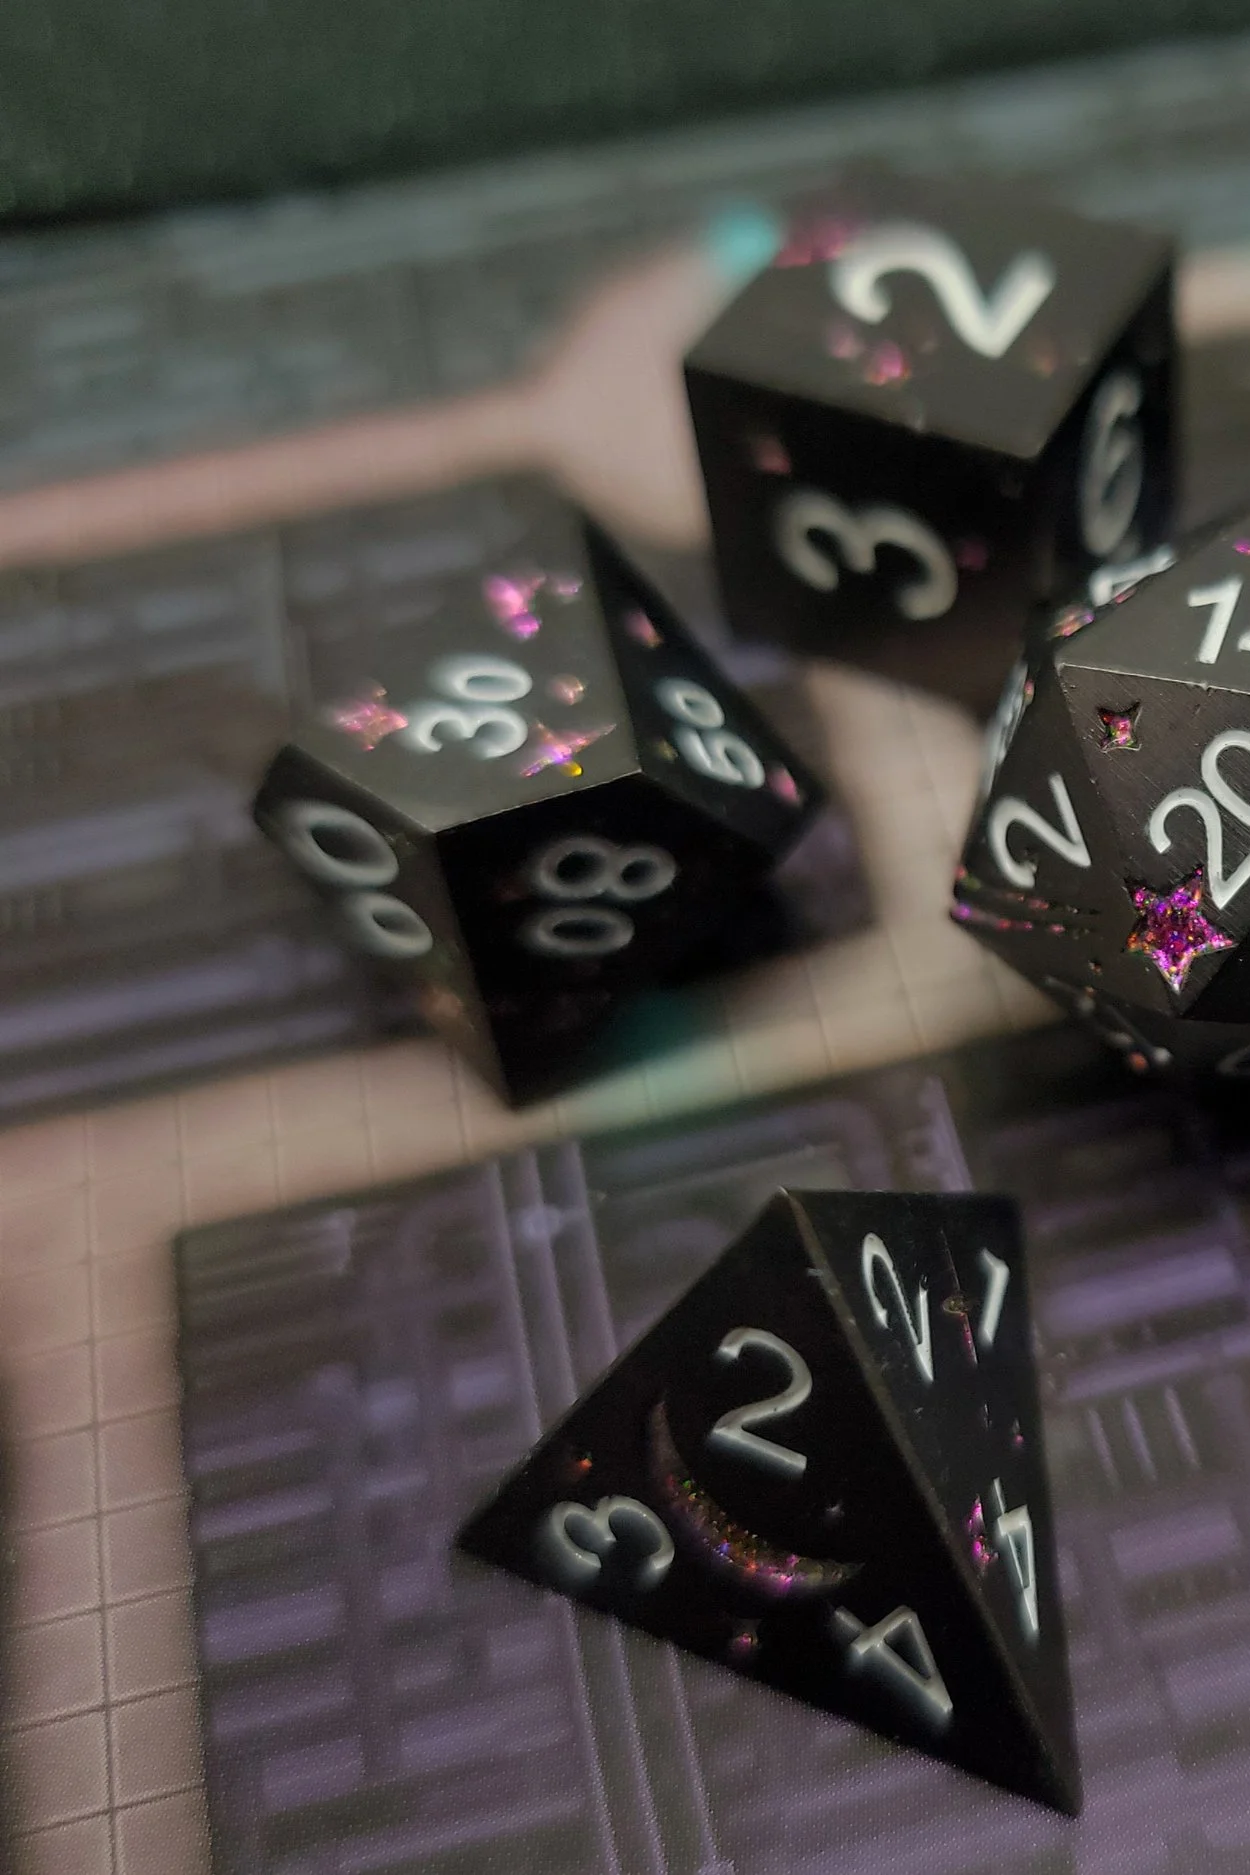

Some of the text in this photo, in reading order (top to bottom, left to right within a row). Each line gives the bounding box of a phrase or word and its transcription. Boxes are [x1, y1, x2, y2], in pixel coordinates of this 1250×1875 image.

[832, 220, 1056, 358] 2
[1080, 364, 1144, 554] 6
[777, 490, 957, 621] 3
[402, 651, 534, 758] 30
[290, 800, 434, 958] 00
[988, 772, 1091, 889] 2
[861, 1231, 934, 1382] 2
[978, 1246, 1010, 1346] 1
[711, 1327, 813, 1474] 2
[548, 1495, 675, 1586] 3
[993, 1476, 1041, 1648] 4
[834, 1602, 953, 1722] 4
